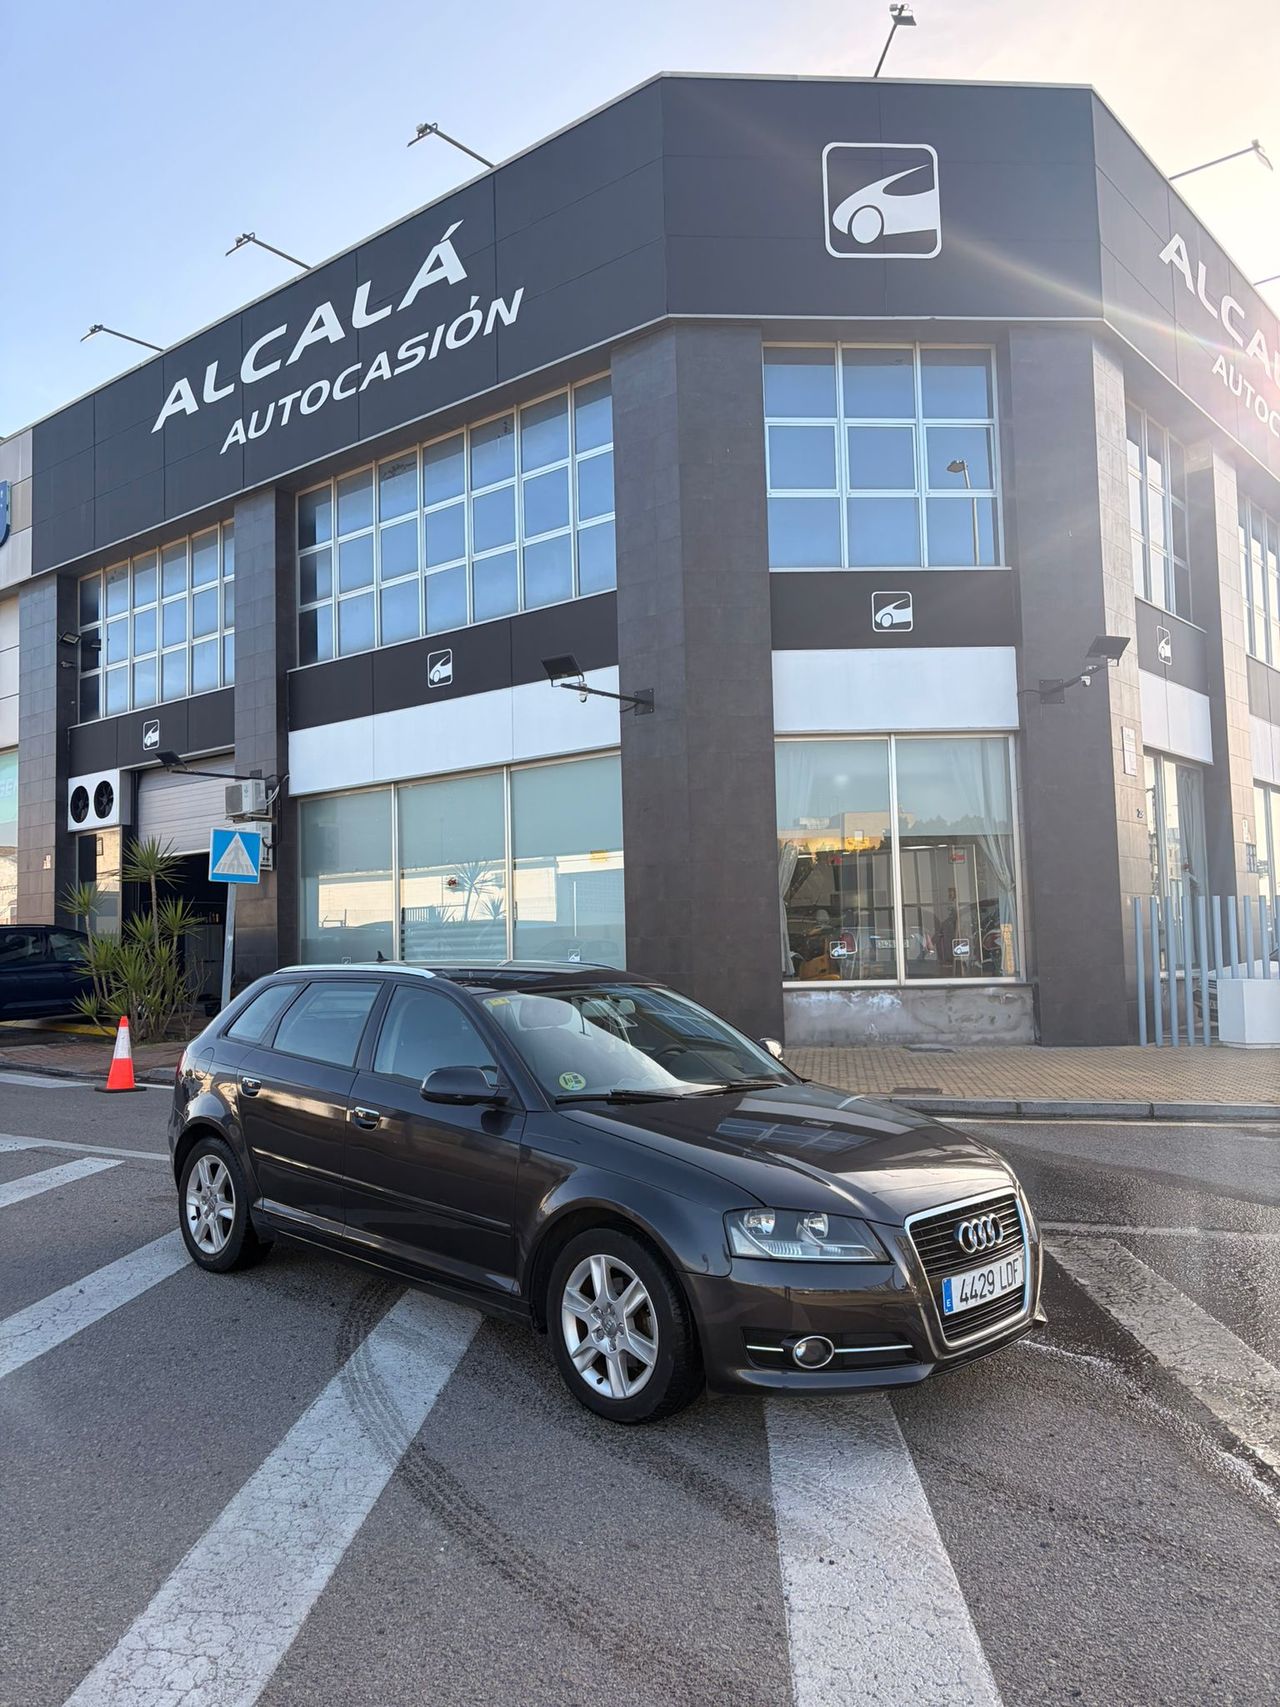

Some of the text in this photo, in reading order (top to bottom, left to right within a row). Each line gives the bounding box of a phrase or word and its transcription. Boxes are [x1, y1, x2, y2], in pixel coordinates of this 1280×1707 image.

[151, 219, 468, 434] ALCALÁ
[220, 287, 525, 455] AUTOCASIÓN
[959, 1269, 995, 1304] 4429
[999, 1258, 1019, 1290] LDF
